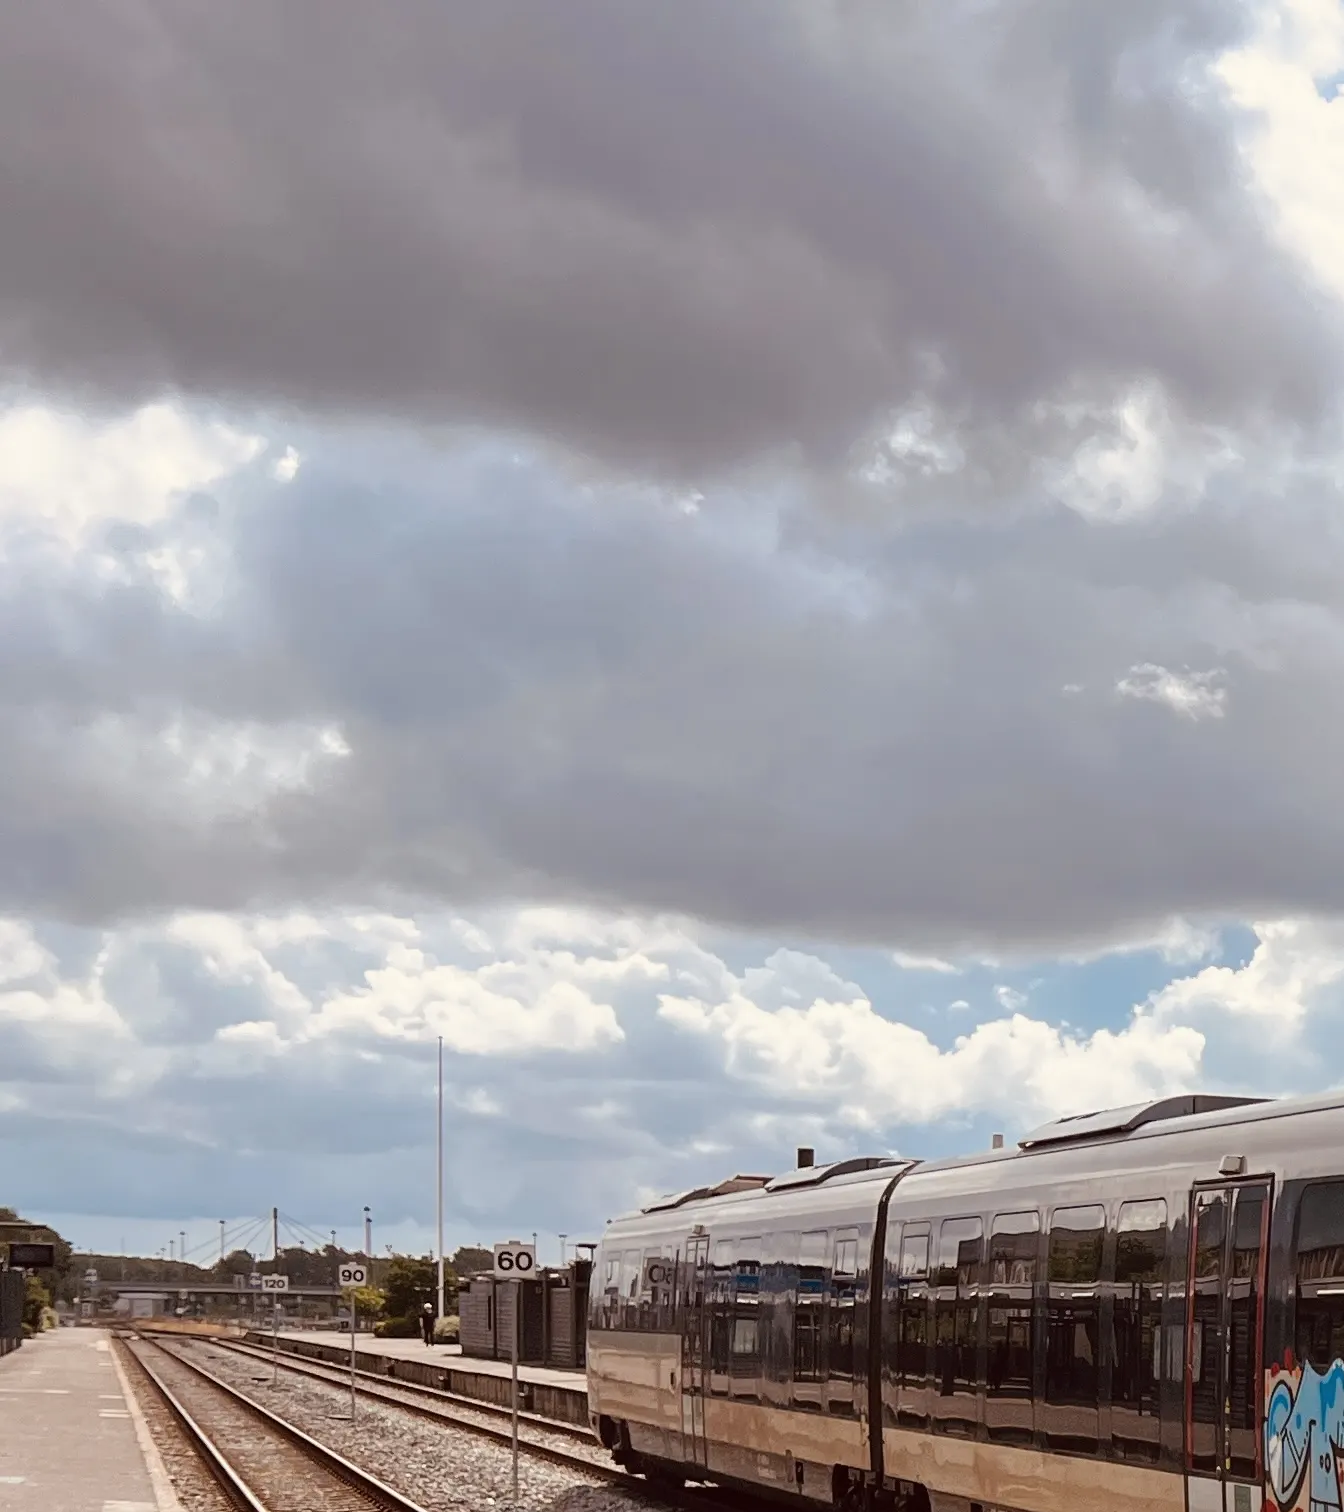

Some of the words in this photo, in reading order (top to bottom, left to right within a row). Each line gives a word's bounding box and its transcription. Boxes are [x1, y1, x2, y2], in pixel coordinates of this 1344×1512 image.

[497, 1251, 533, 1271] 60
[341, 1269, 365, 1283] 90
[264, 1278, 286, 1290] 120
